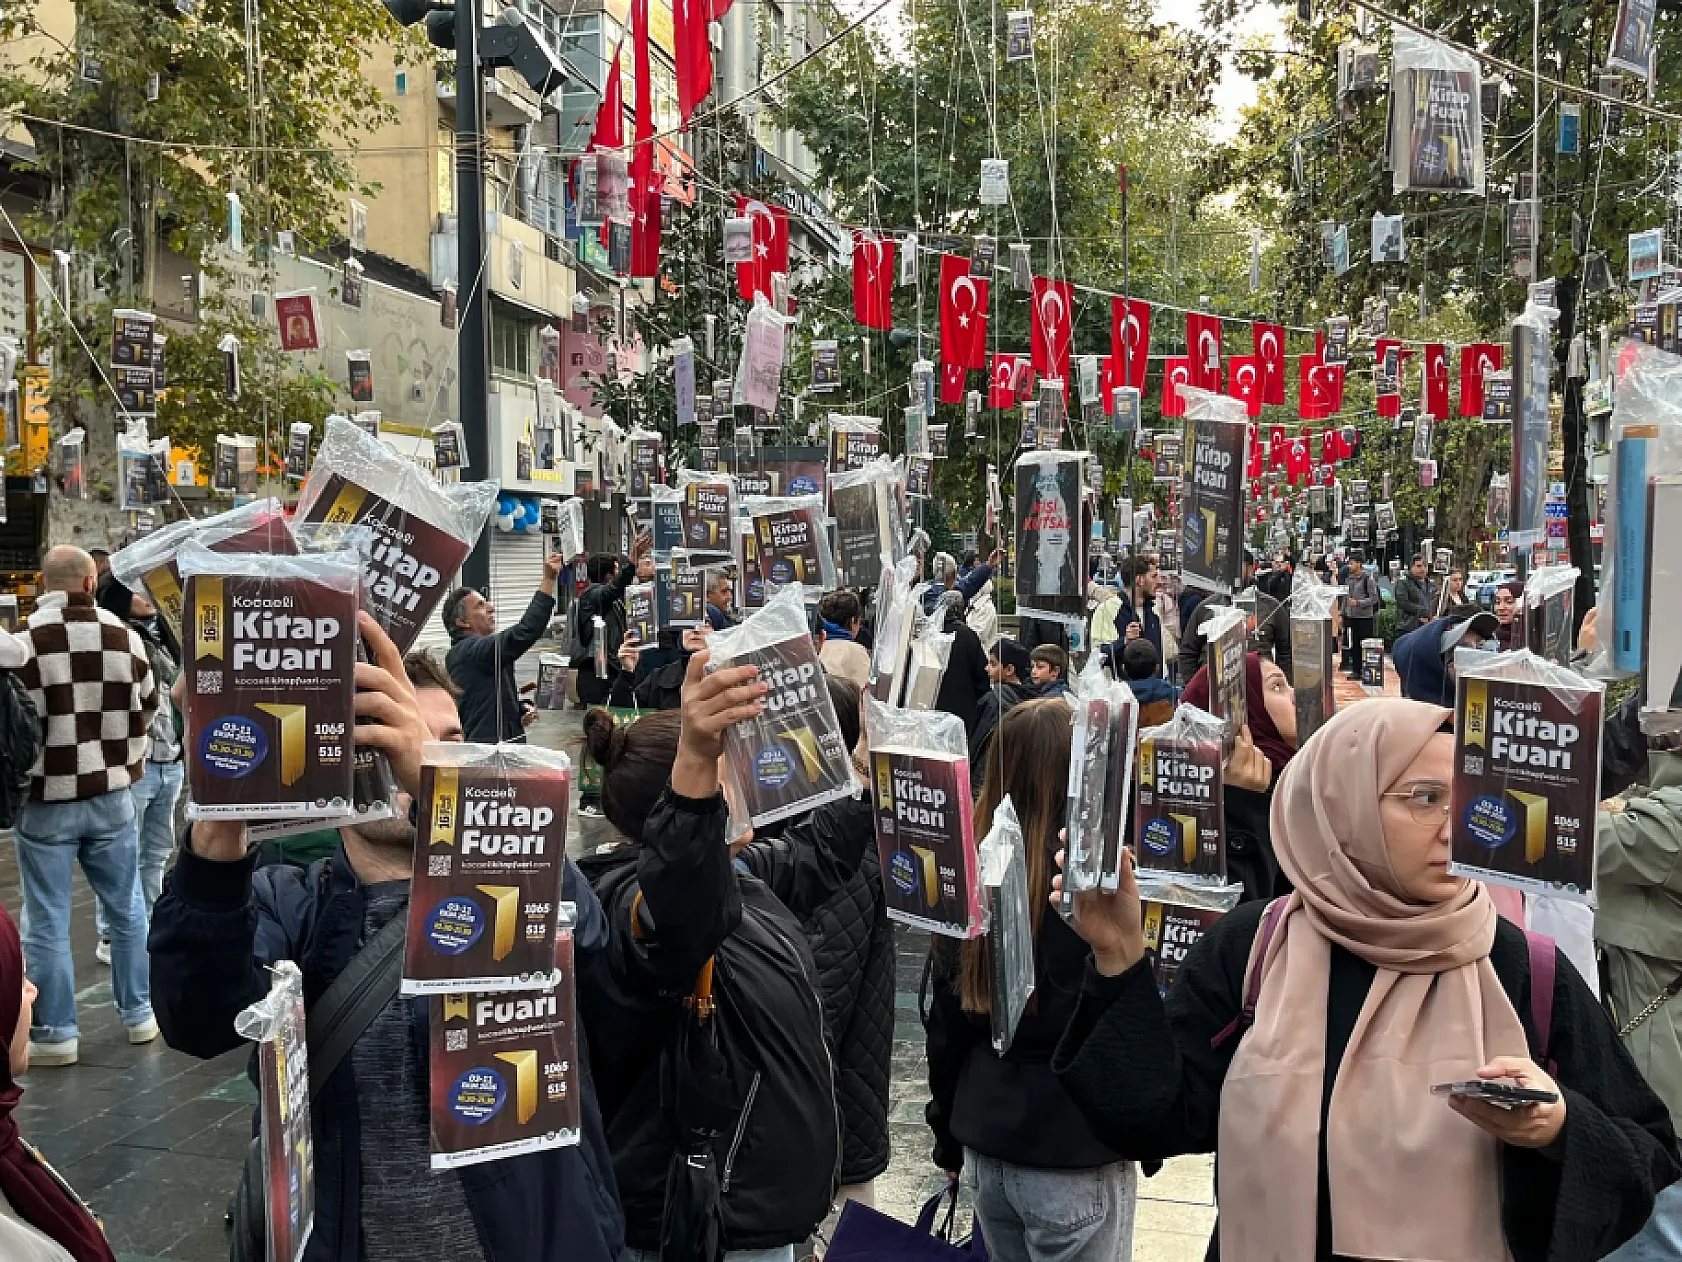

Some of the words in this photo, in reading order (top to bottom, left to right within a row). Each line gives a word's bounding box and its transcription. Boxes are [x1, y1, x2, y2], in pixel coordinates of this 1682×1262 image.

[848, 441, 879, 456] Kitap
[1196, 443, 1231, 470] Kitap
[1194, 464, 1227, 489] Fuarı
[772, 521, 807, 537] Kitap
[774, 533, 807, 547] Fuarı
[362, 560, 421, 612] uarı
[233, 595, 294, 608] Kocaeli
[233, 611, 340, 645] Kitap
[233, 642, 332, 670] Fuarı
[760, 663, 814, 689] itap
[1493, 696, 1542, 712] Kocaeli
[314, 722, 345, 735] 1065
[1493, 709, 1580, 748] Kitap
[319, 746, 342, 757] 515
[1492, 737, 1571, 770] Fuarı
[1157, 759, 1214, 783] Kitap
[465, 786, 517, 799] Kocaeli
[895, 779, 947, 809] Kitap
[1157, 777, 1210, 798] Fuarı
[464, 801, 554, 832] Kitap
[895, 801, 945, 829] Fuarı
[461, 829, 545, 855] Fuarı
[524, 903, 551, 914] 1065
[526, 923, 546, 935] 515
[476, 996, 557, 1026] Fuarı
[544, 1060, 569, 1075] 1065
[547, 1081, 567, 1094] 515
